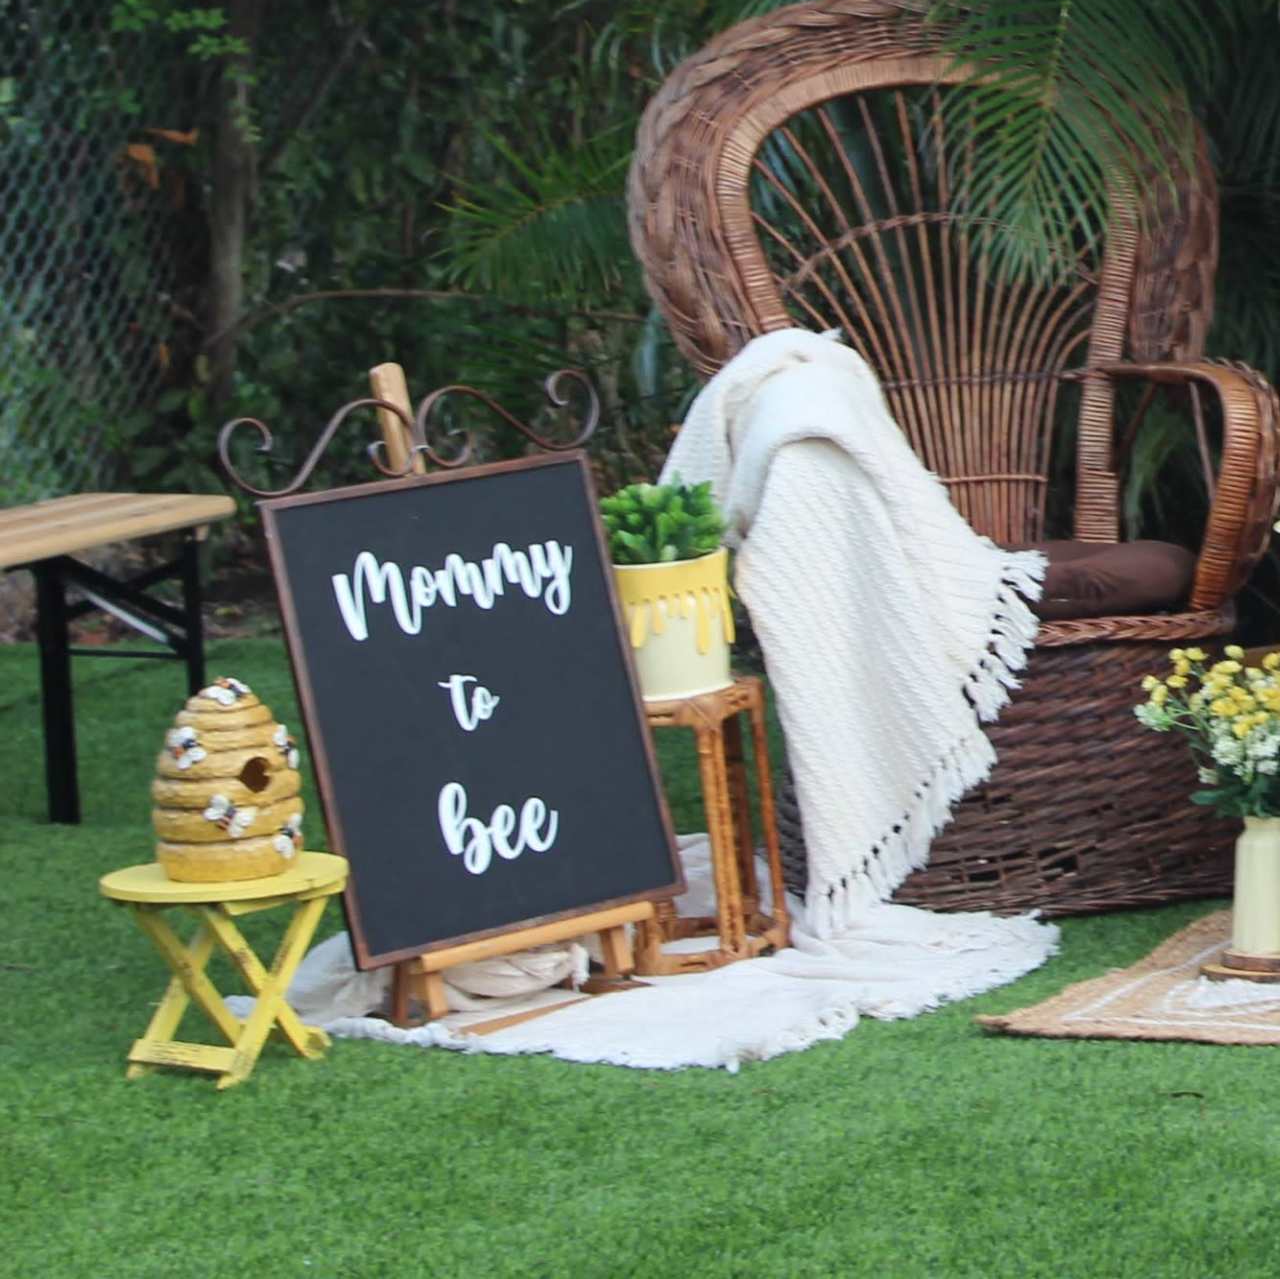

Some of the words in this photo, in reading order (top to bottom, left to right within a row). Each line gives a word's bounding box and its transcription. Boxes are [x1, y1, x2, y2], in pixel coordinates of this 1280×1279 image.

[332, 540, 573, 641] Mommy
[438, 675, 500, 732] to
[437, 782, 558, 875] bee
